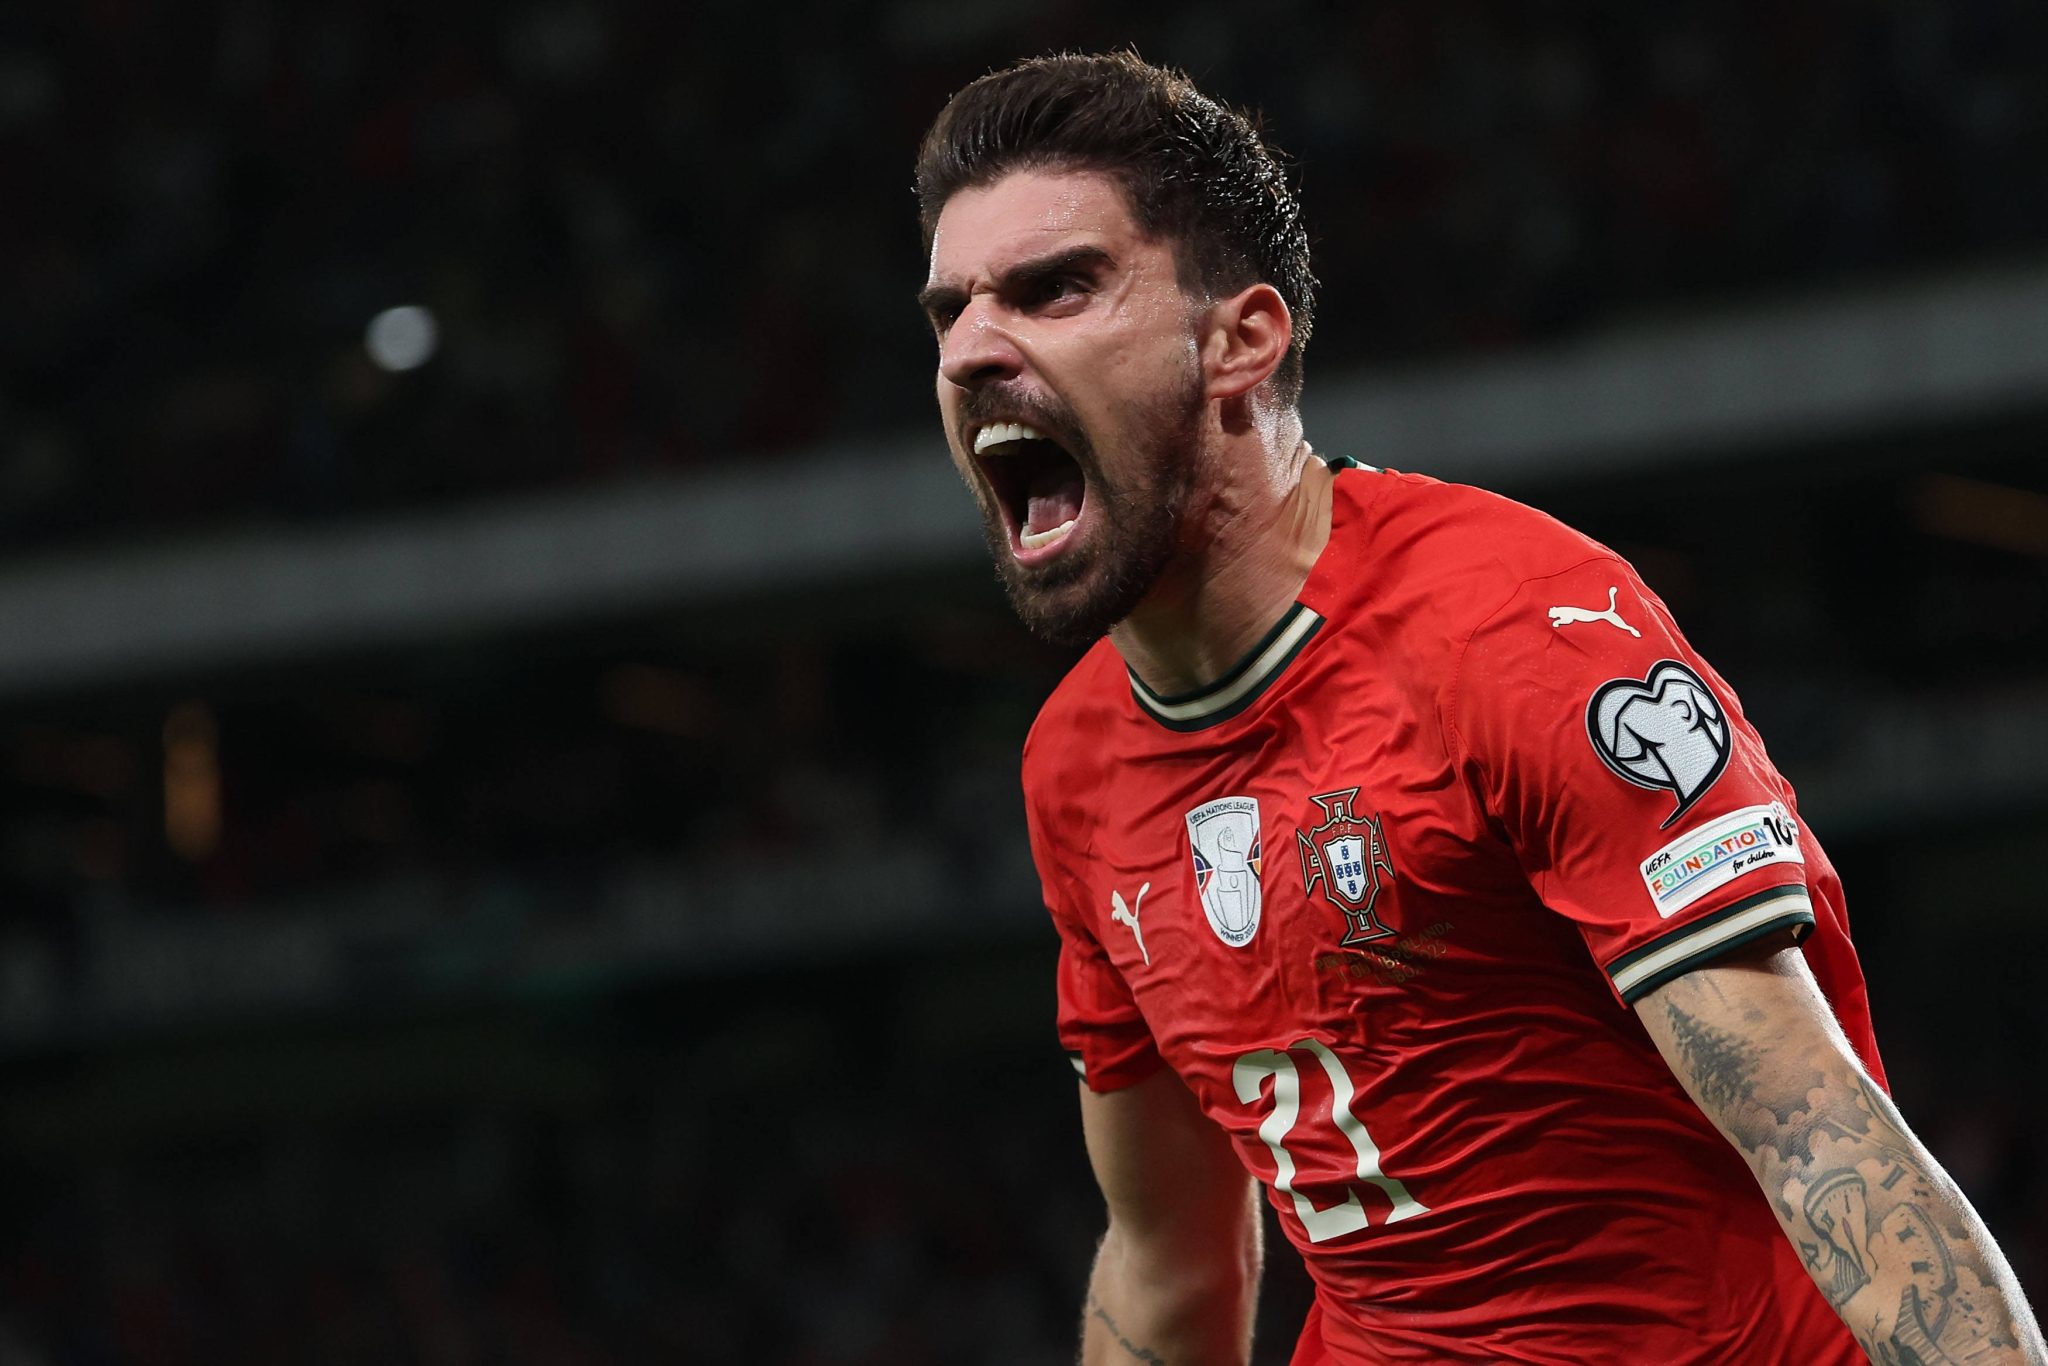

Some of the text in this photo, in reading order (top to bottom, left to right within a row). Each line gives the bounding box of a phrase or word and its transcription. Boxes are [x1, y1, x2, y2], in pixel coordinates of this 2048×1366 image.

[1189, 801, 1255, 825] UEFA NATIONS LEAGUE
[1645, 852, 1671, 876] UEFA
[1733, 850, 1776, 874] for children
[1220, 927, 1244, 942] WINNER
[1232, 1037, 1432, 1244] 21
